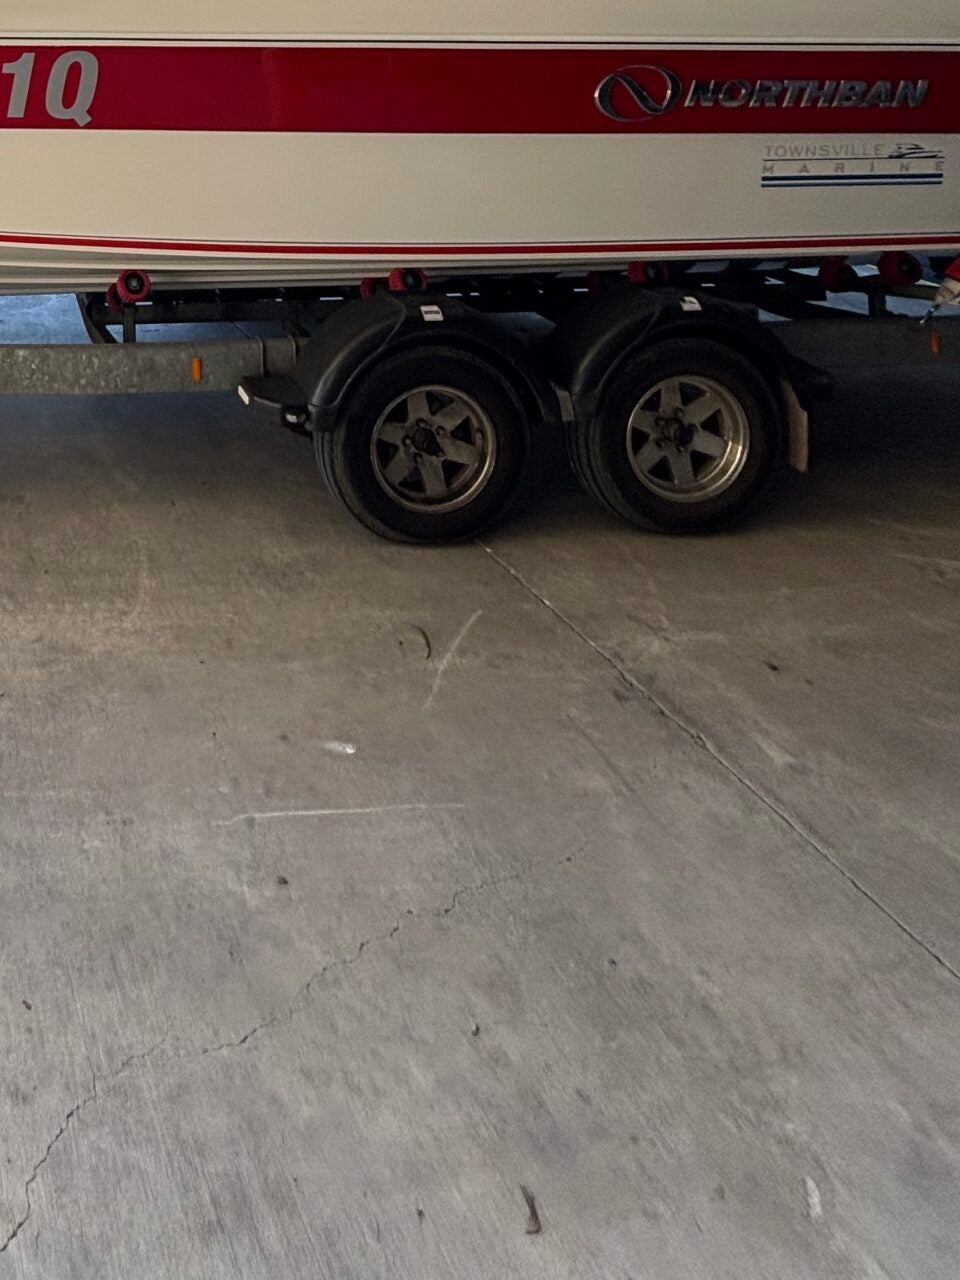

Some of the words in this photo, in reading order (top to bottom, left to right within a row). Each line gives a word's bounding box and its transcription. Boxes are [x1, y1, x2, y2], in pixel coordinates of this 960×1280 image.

[684, 79, 929, 108] NORTHBAN
[764, 144, 886, 158] TOWNSVILLE
[761, 160, 945, 175] MARINE
